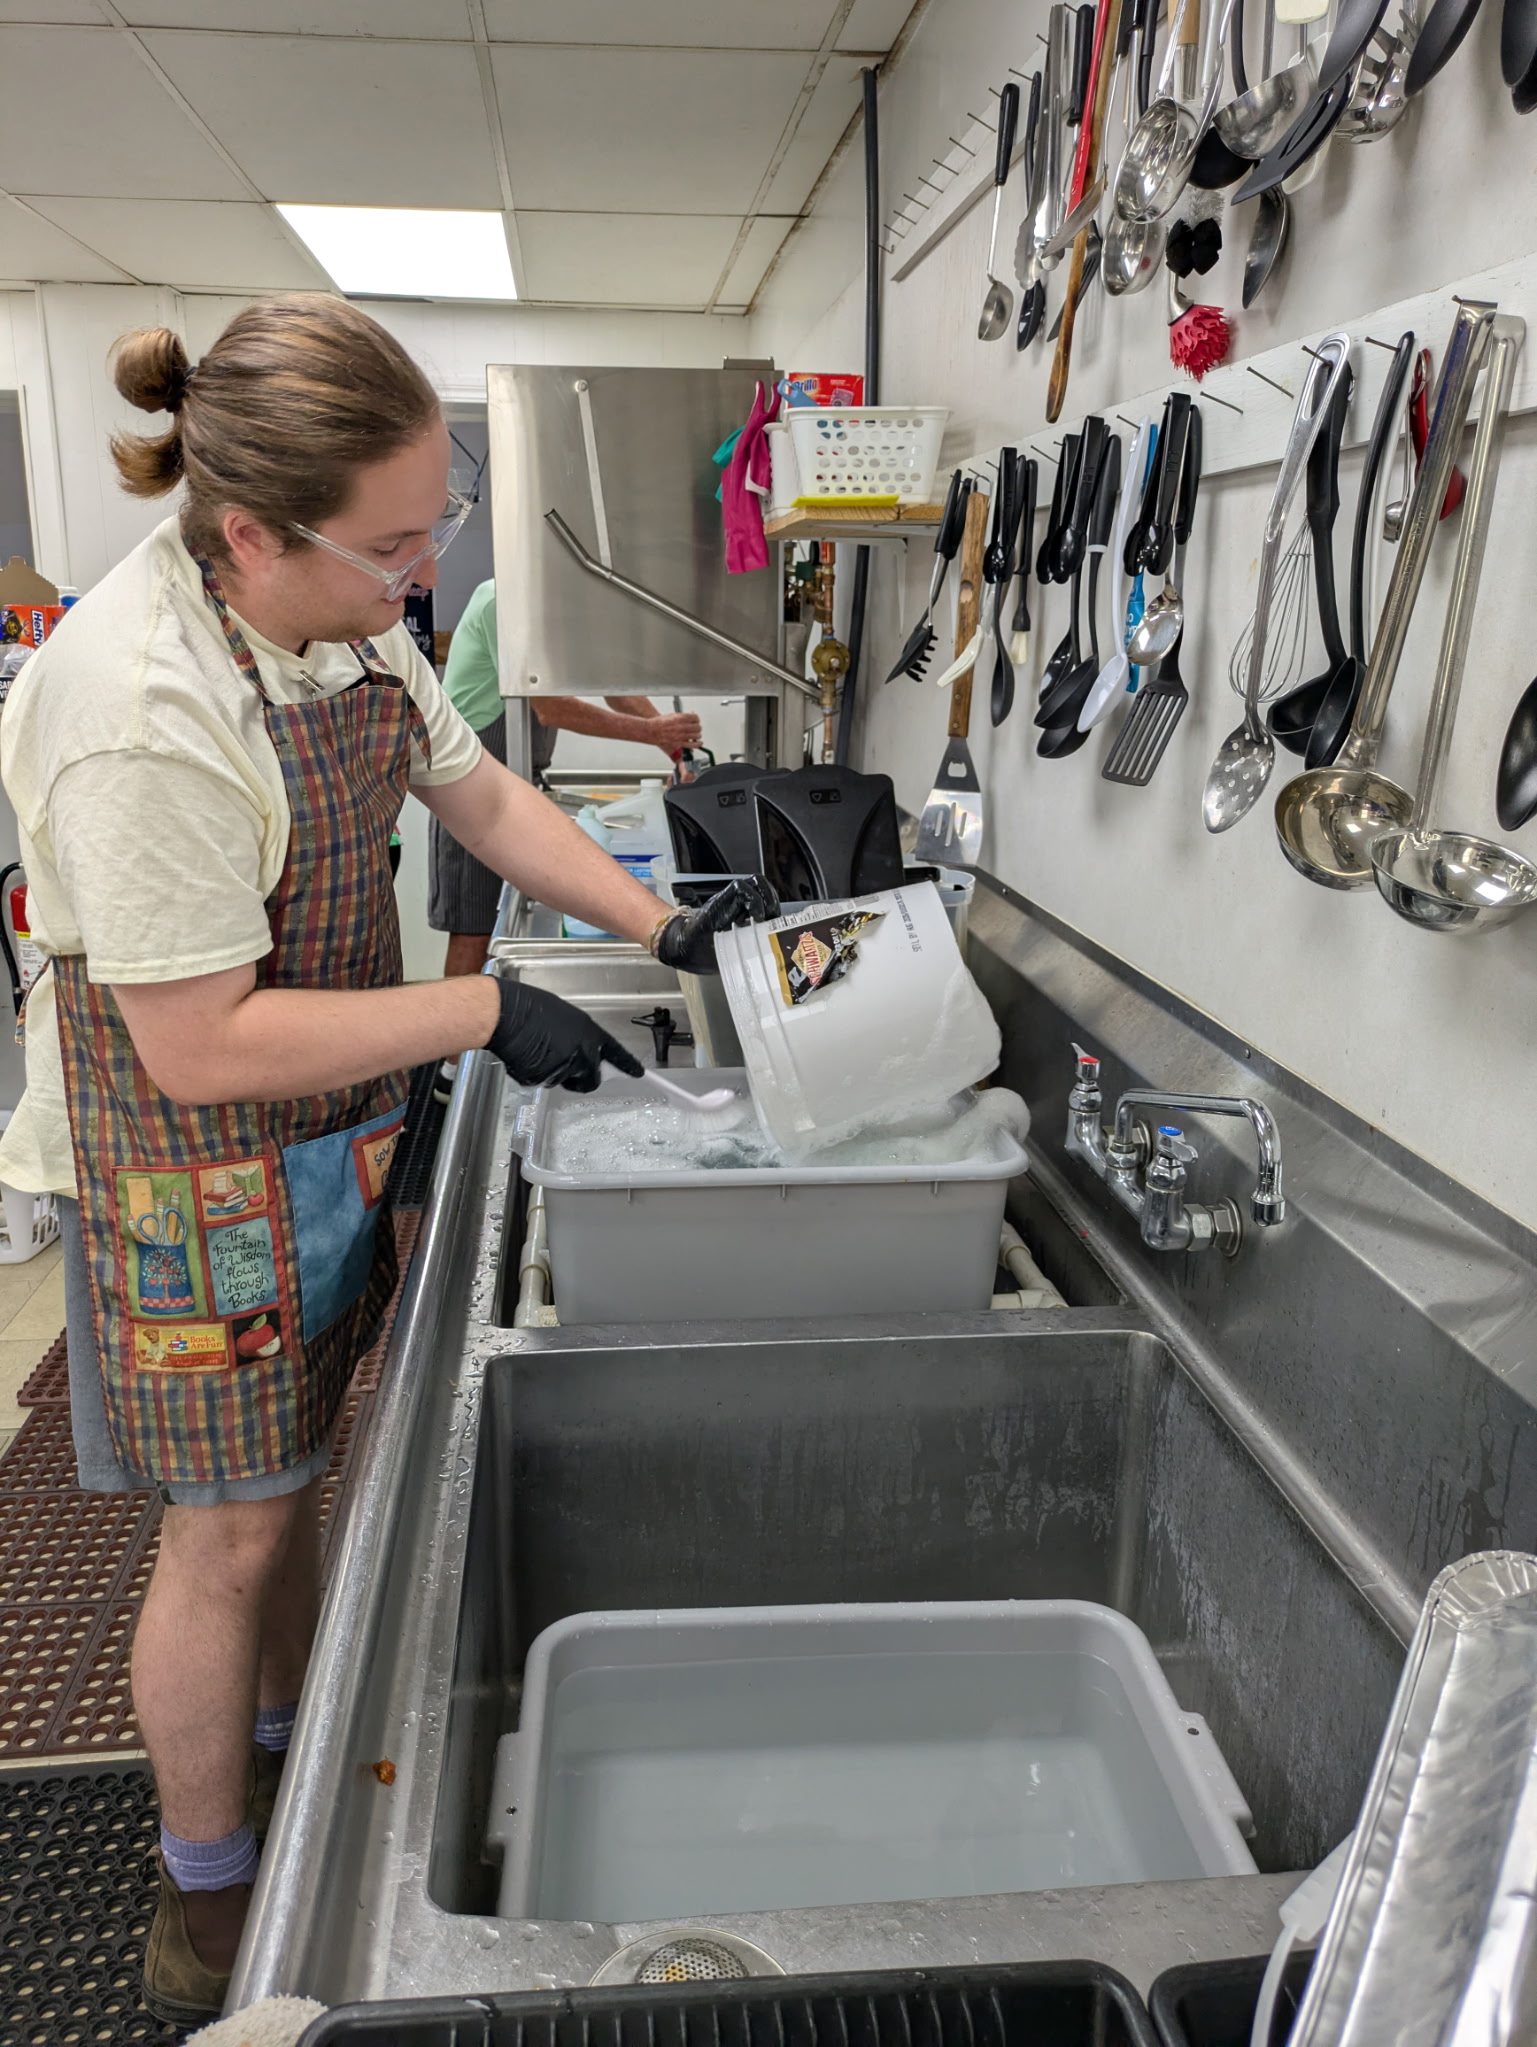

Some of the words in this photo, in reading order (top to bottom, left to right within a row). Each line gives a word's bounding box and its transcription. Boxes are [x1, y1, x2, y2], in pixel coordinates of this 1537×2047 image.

[33, 611, 44, 646] Hefty
[225, 1228, 248, 1241] The
[213, 1240, 266, 1256] Fountain
[213, 1257, 226, 1270] of
[228, 1249, 271, 1266] Wisdom
[227, 1262, 259, 1279] flows
[221, 1272, 269, 1294] through
[228, 1290, 266, 1309] Books
[190, 1335, 216, 1343] Books
